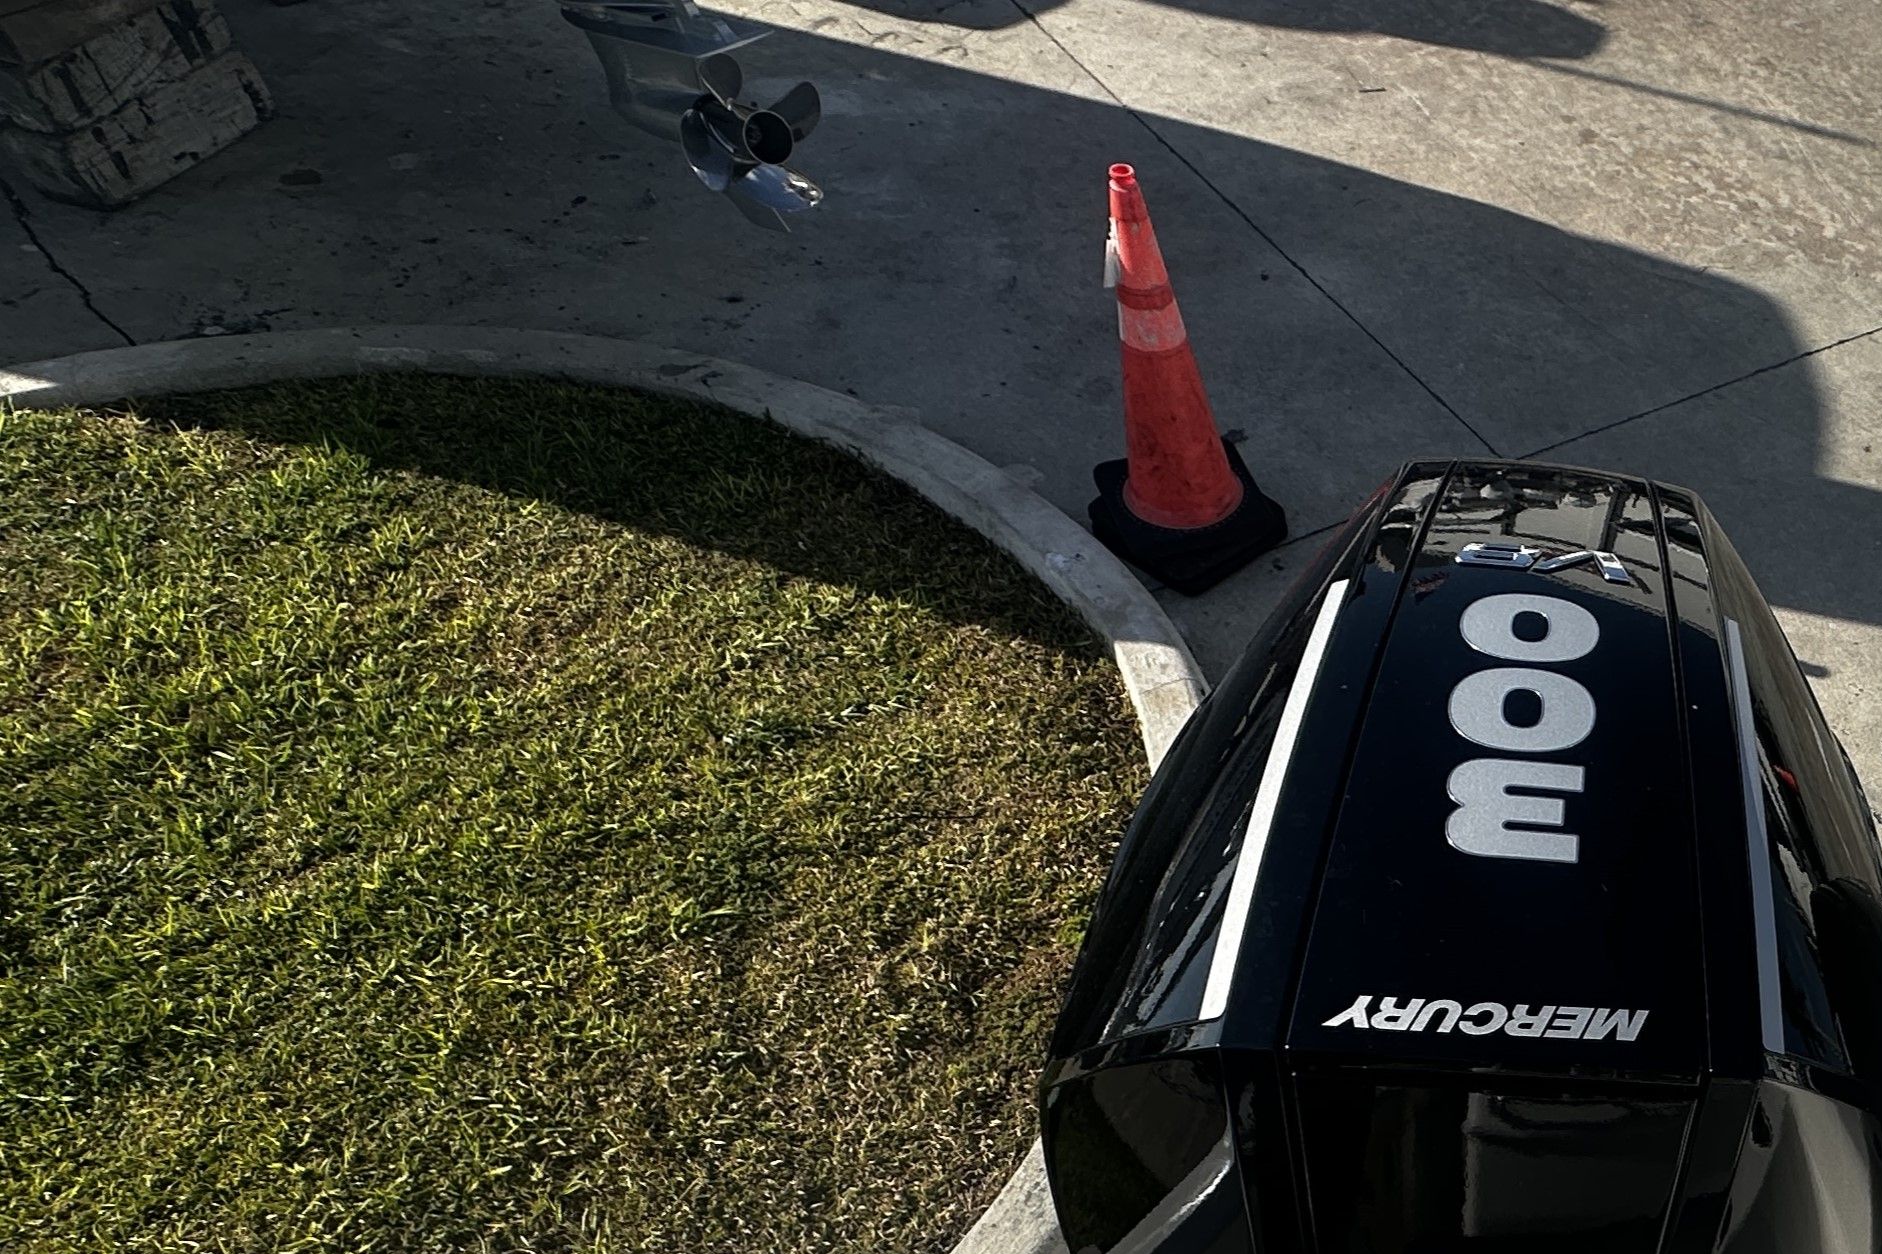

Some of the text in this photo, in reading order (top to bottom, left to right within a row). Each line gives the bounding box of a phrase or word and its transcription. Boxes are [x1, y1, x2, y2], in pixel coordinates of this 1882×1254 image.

[1454, 542, 1632, 585] V8
[1445, 593, 1601, 864] 300
[1322, 995, 1650, 1042] MERCURY
